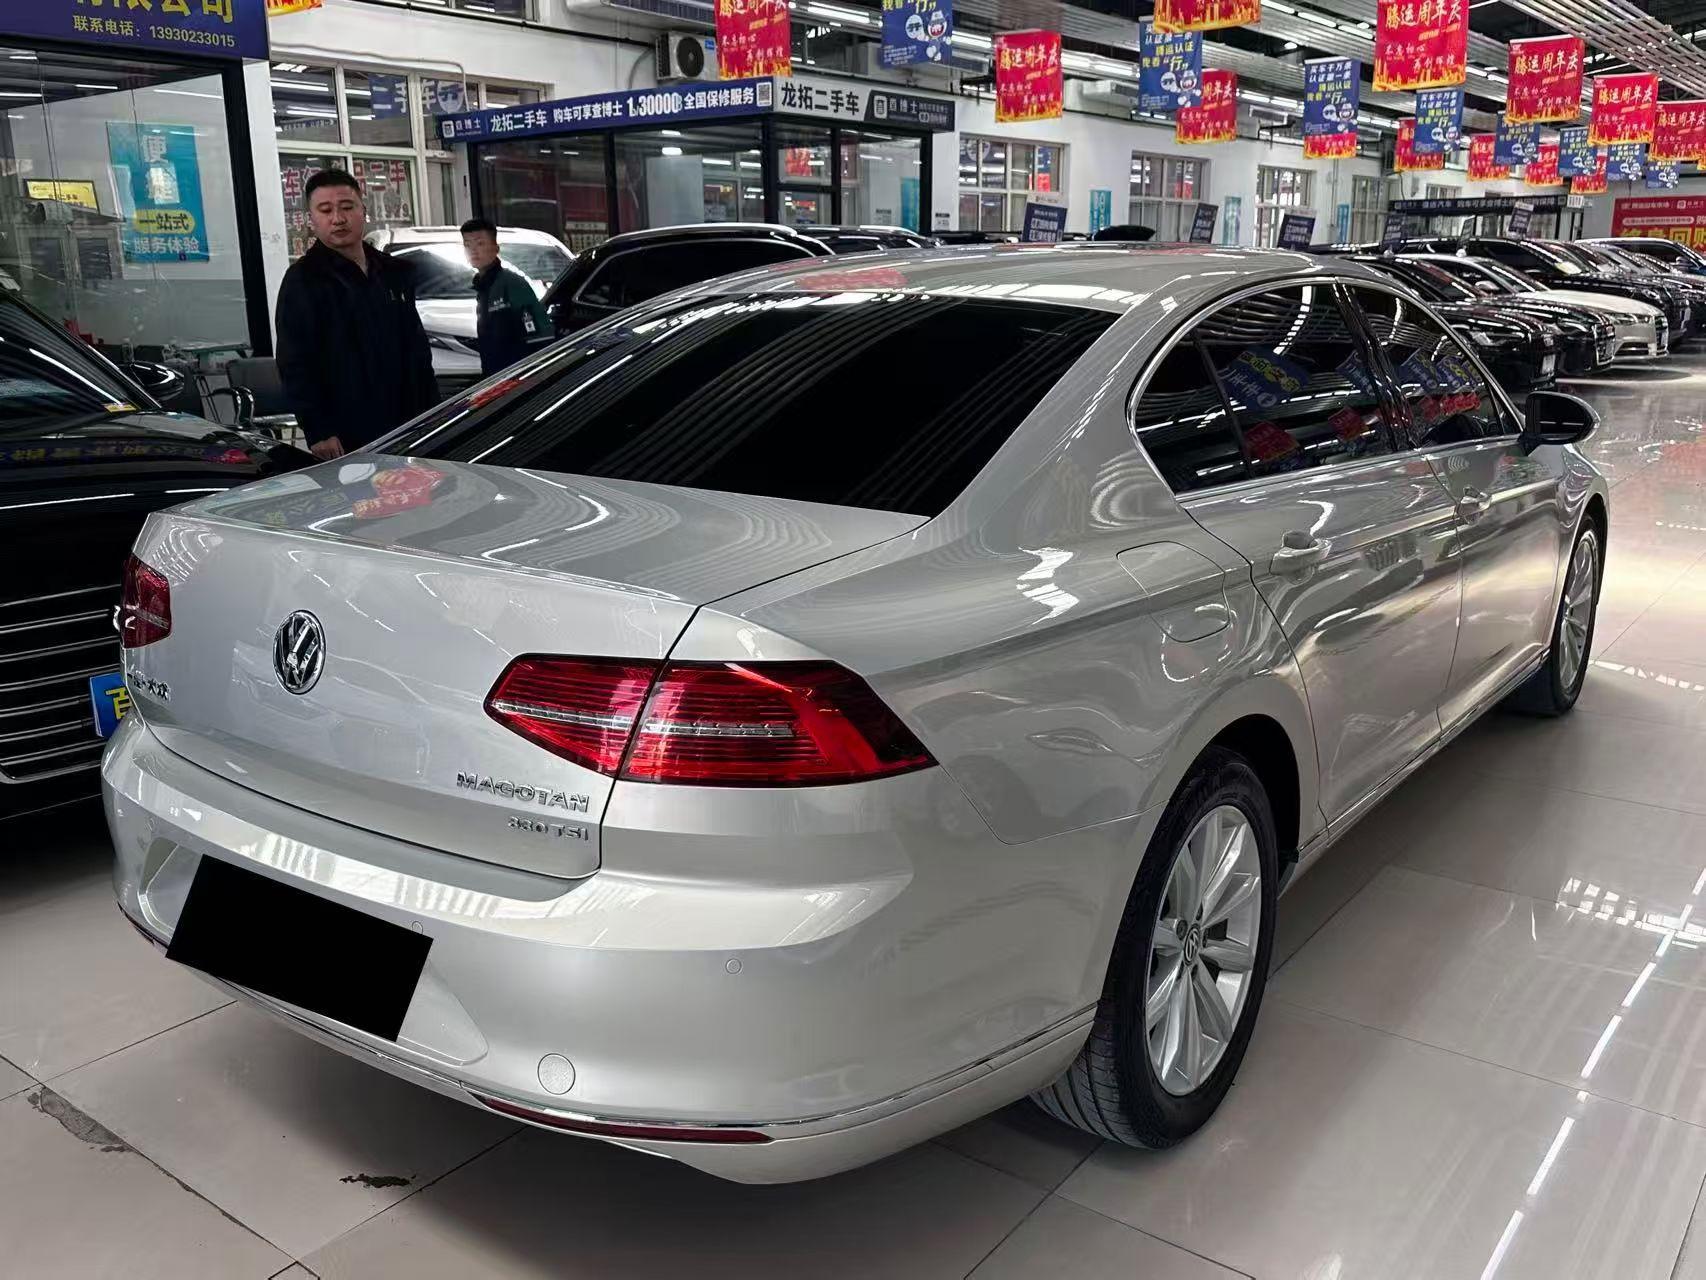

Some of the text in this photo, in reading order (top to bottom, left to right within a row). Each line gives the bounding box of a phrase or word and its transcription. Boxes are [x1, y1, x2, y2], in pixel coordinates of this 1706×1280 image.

[150, 26, 234, 47] 13930233015
[491, 109, 548, 132] 龙拓二手车
[553, 100, 623, 124] 购车可享查博士
[684, 87, 754, 110] 全国保修服务
[781, 82, 859, 115] 龙拓二手车
[456, 770, 590, 813] MAGOTAN
[550, 823, 589, 841] TSI
